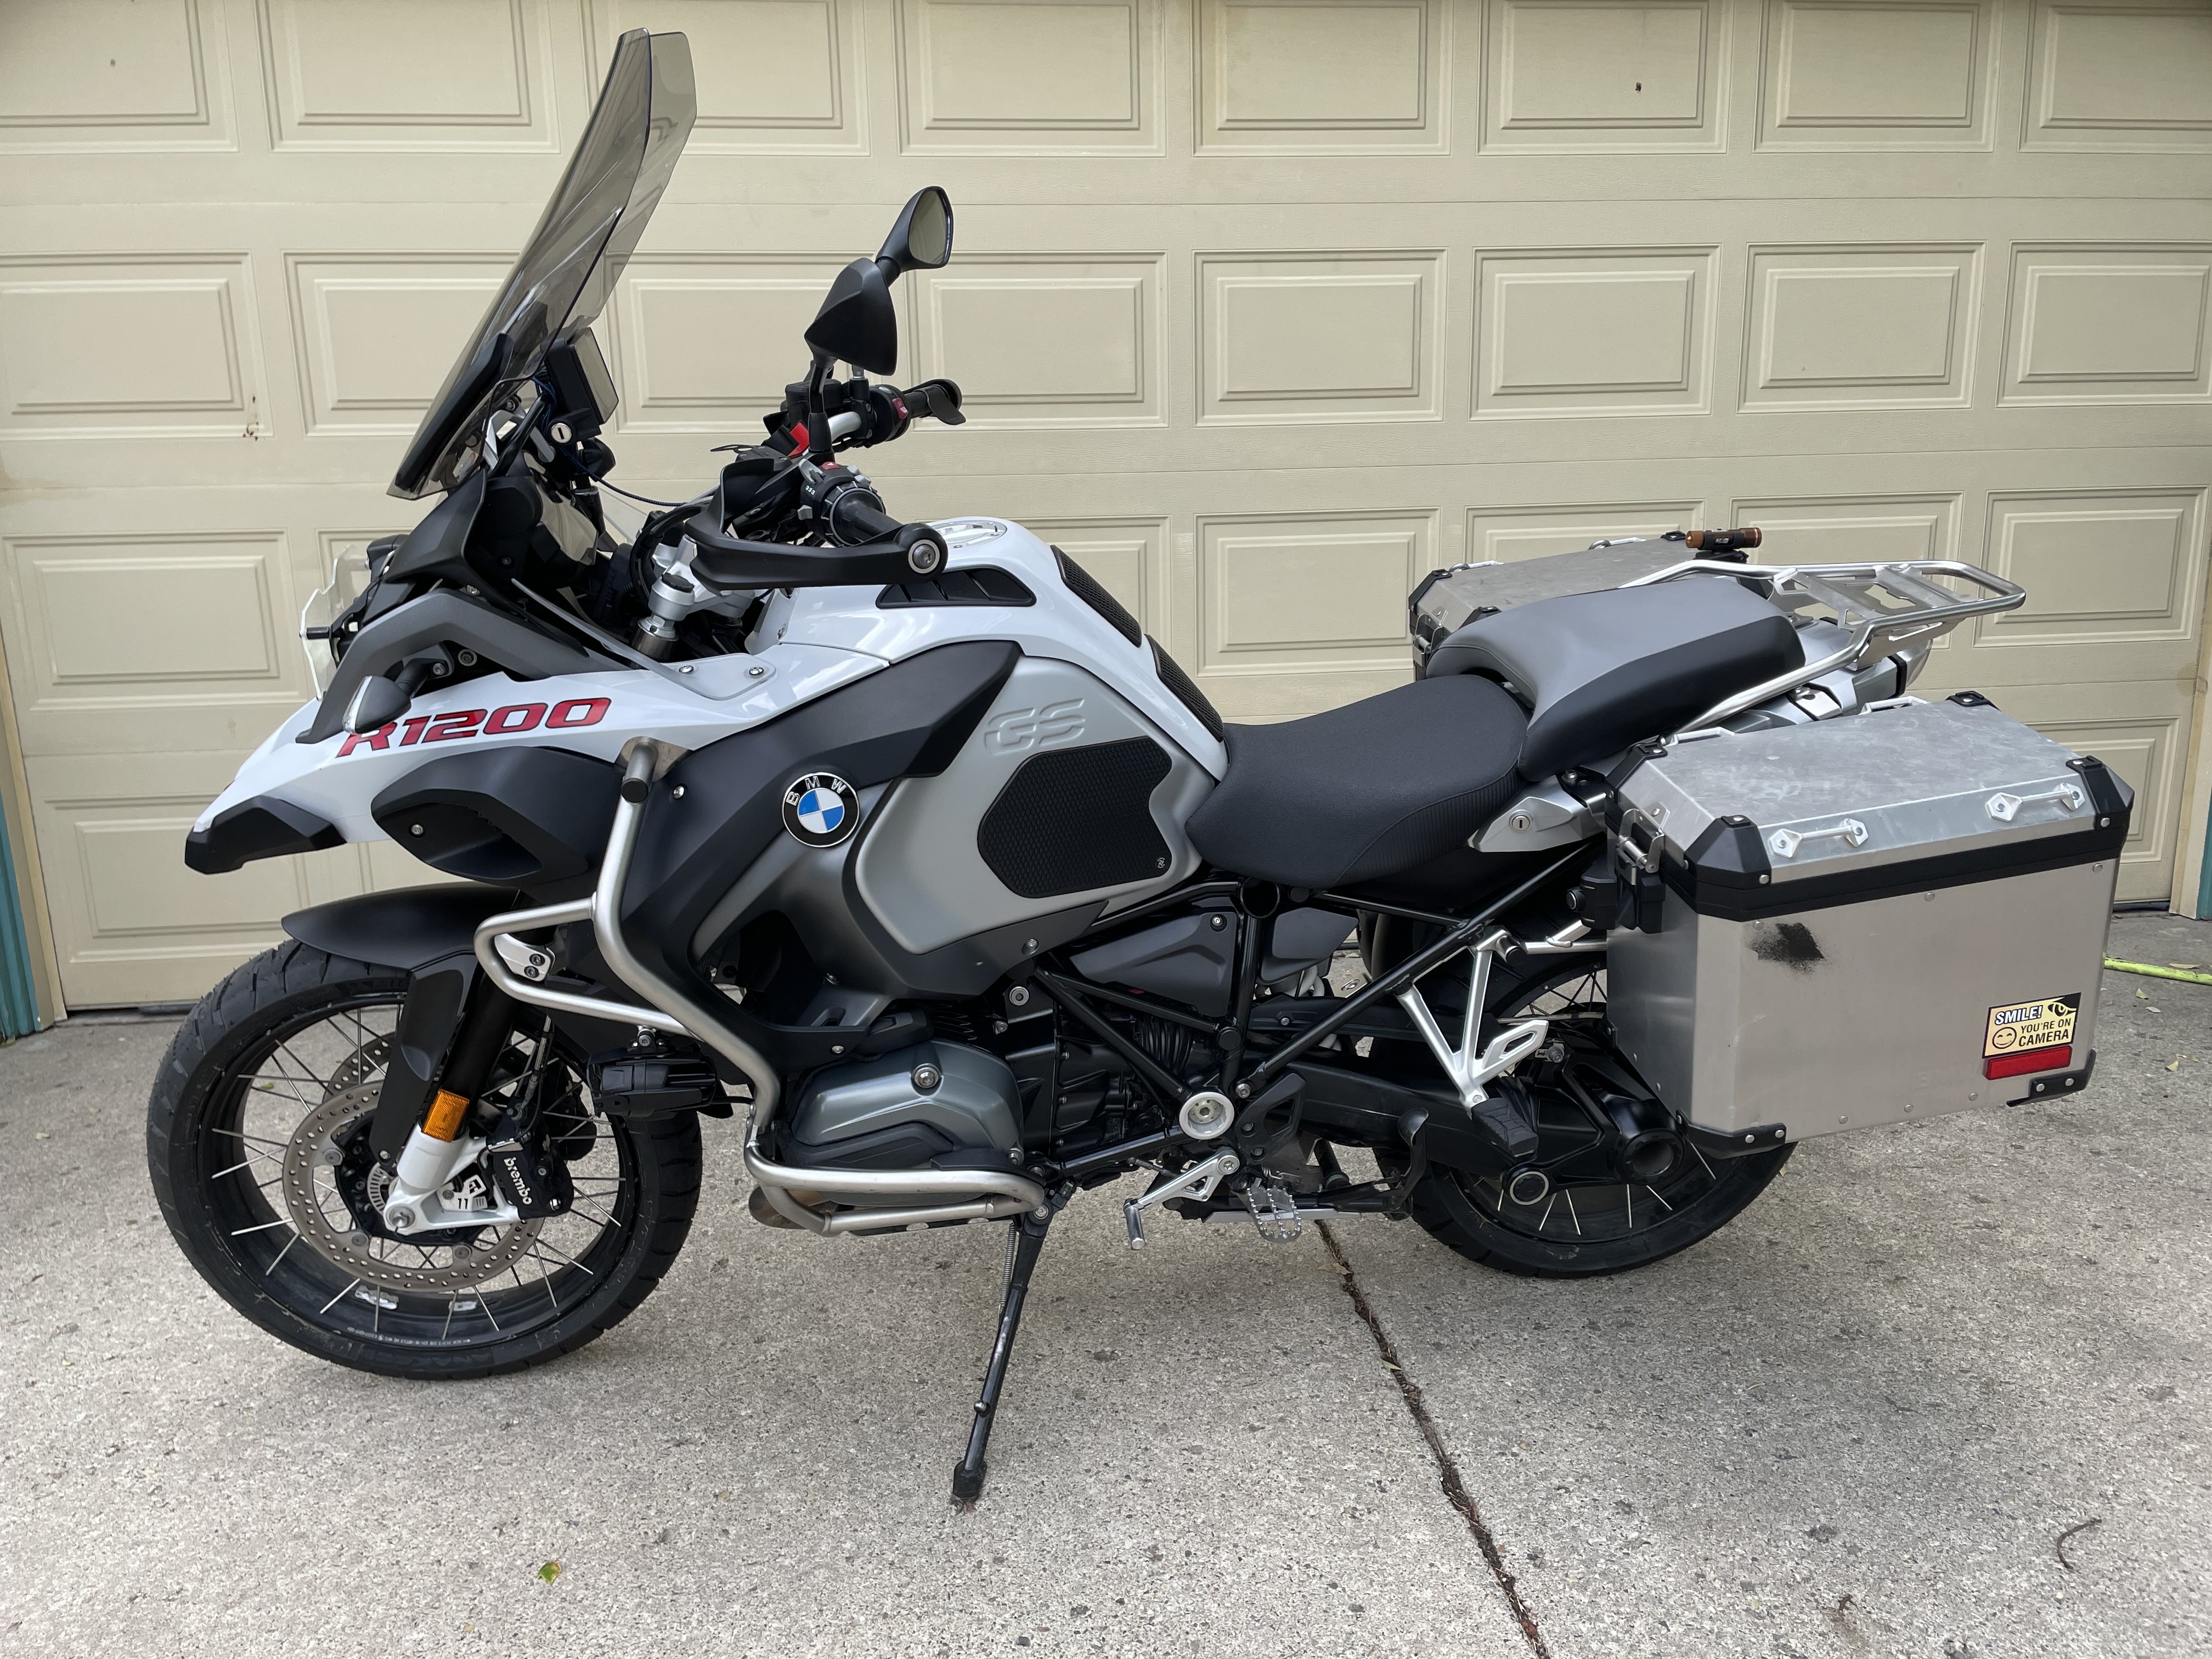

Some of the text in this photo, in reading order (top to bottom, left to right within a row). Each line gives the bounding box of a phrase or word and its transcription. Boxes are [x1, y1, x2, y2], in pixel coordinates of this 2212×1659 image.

[335, 697, 612, 758] R1200
[984, 697, 1085, 757] GS
[786, 775, 847, 806] BMW
[1994, 1005, 2044, 1025] SMILE!
[2021, 1018, 2072, 1034] YOU'RE ON
[2018, 1029, 2069, 1047] CAMERA
[503, 1156, 533, 1205] brembo
